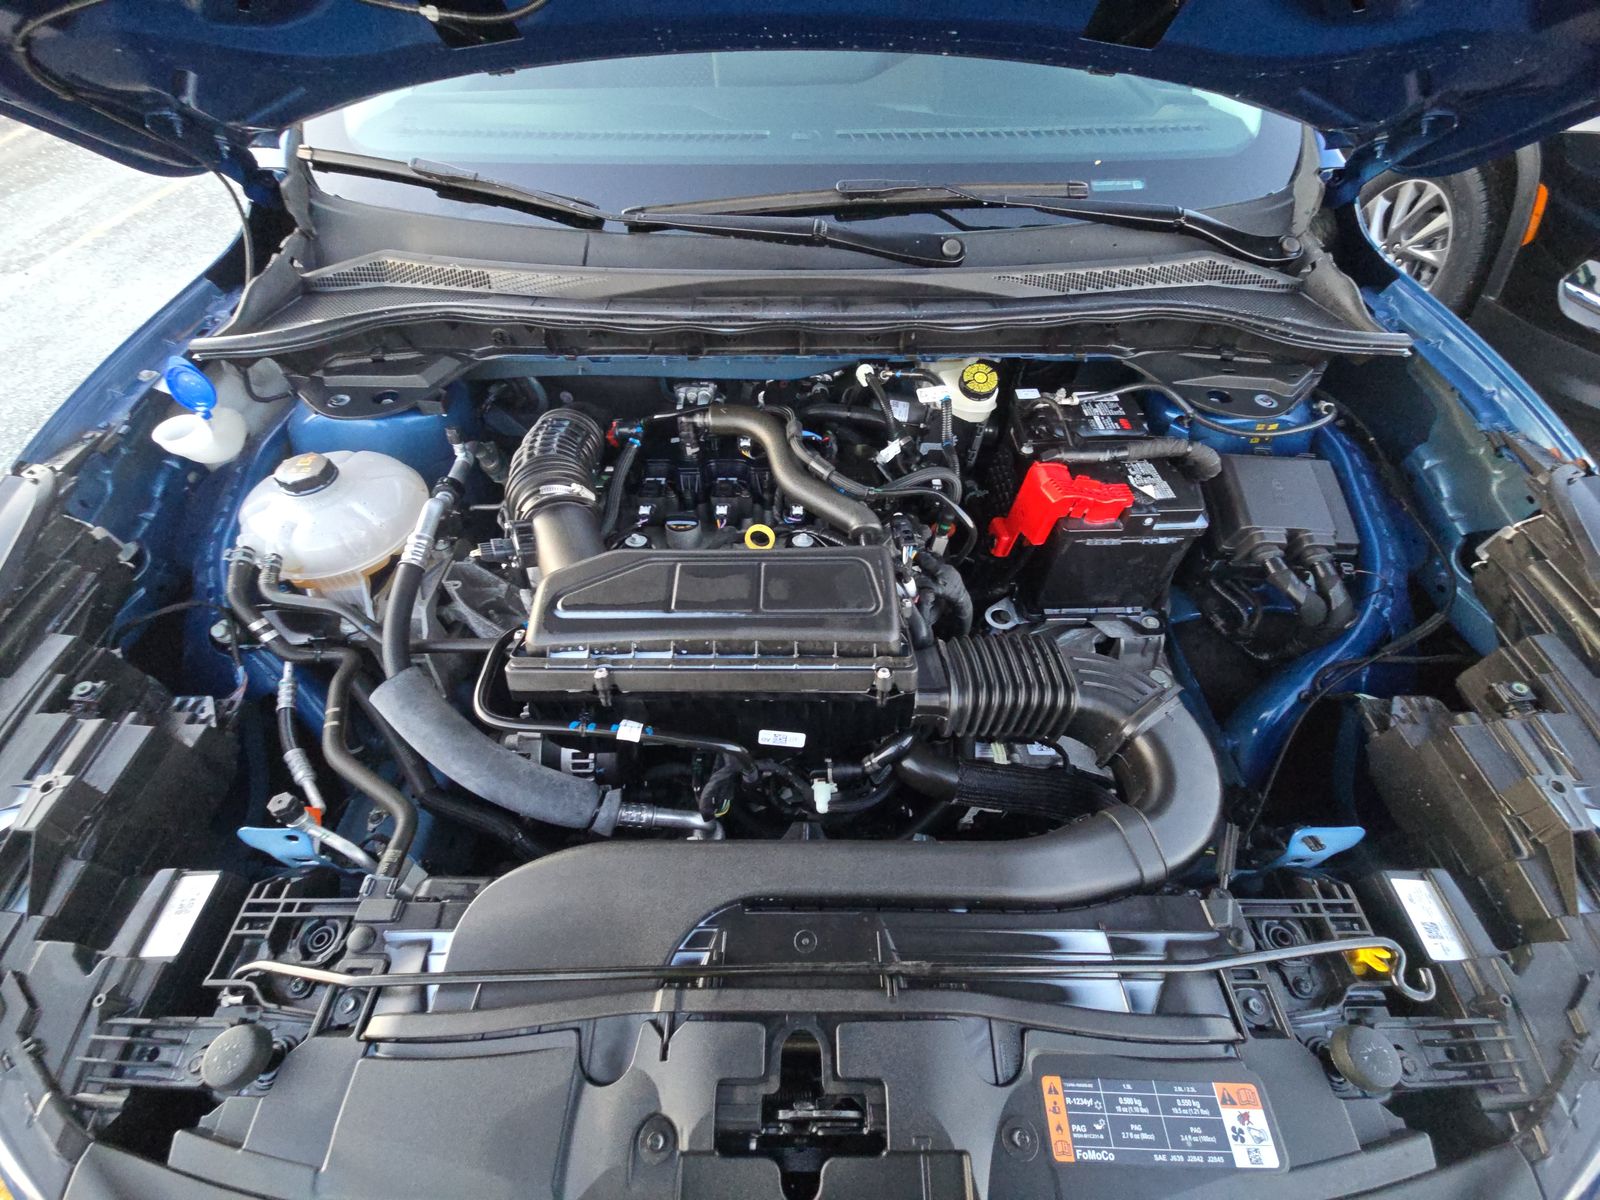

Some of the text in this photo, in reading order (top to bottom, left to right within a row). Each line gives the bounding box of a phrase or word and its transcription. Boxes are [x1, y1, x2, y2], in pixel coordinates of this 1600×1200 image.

[1065, 1097, 1093, 1107] R-1234yf
[1133, 1098, 1142, 1107] kg
[1191, 1100, 1201, 1108] kg
[1071, 1124, 1087, 1133] PAG
[1075, 1149, 1116, 1161] FoMoCo
